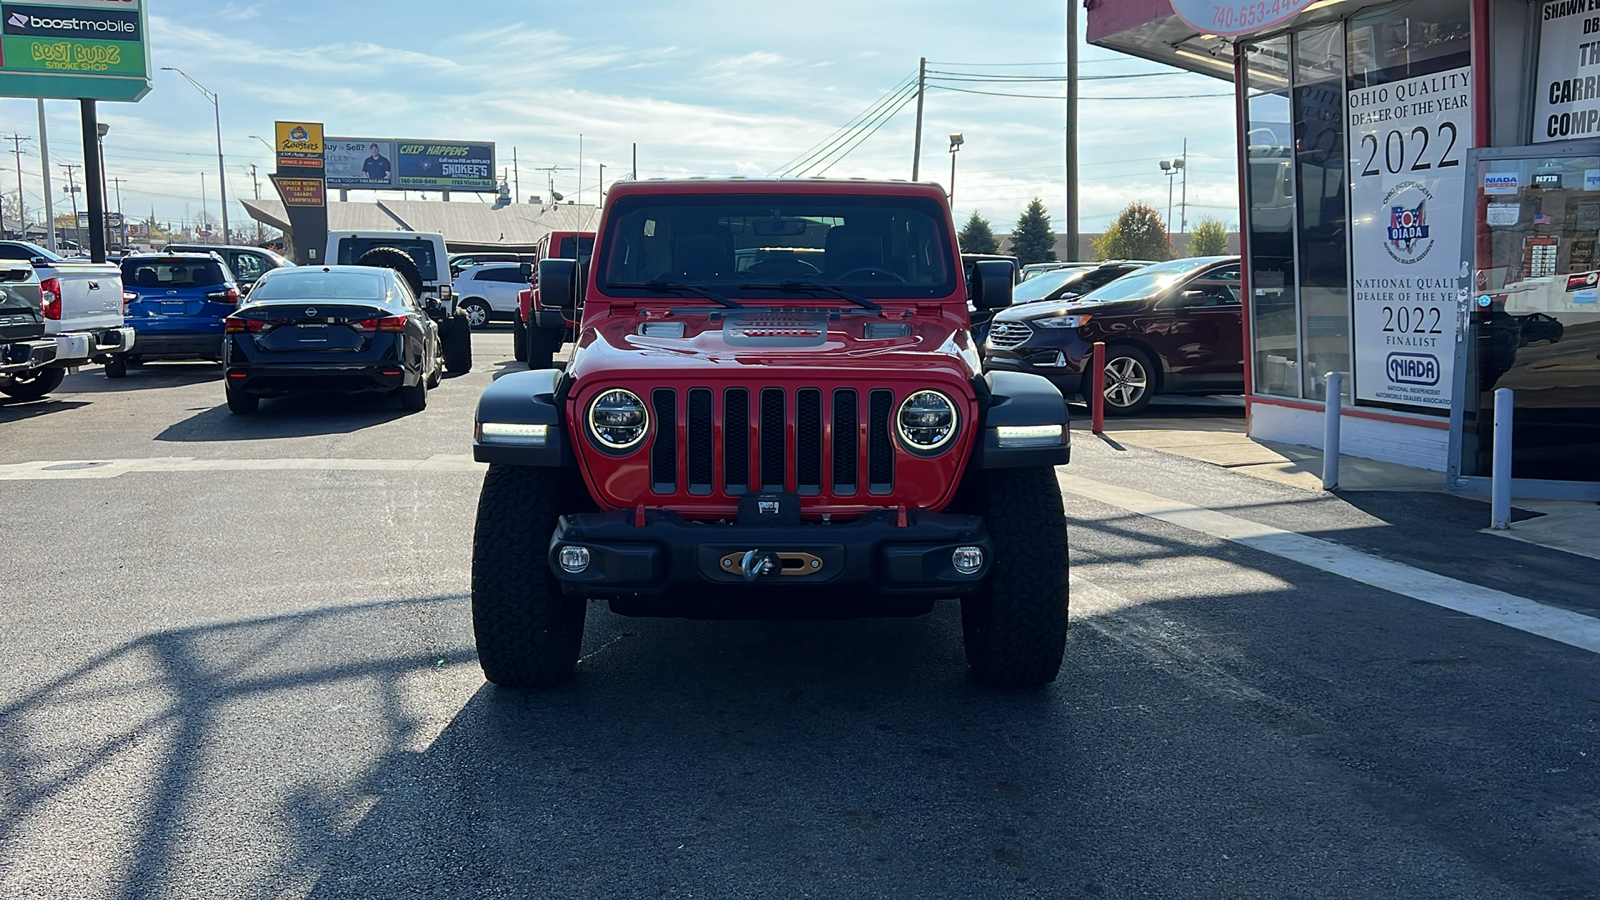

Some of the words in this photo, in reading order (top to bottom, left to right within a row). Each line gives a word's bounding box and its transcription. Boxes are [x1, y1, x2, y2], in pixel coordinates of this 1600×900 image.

[1544, 0, 1586, 20] SHAWN
[46, 61, 79, 71] SMOKE
[81, 63, 108, 71] SHOP
[1350, 88, 1388, 108] OHIO
[1396, 71, 1470, 102] QUALITY
[1352, 108, 1392, 126] DEALER
[1394, 105, 1409, 119] OF
[1411, 100, 1434, 116] THE
[1437, 94, 1469, 112] YEAR
[282, 139, 319, 151] Roosters
[346, 143, 365, 151] Sell?
[400, 145, 425, 155] CHIP
[426, 145, 470, 157] HAPPENS
[1361, 121, 1459, 177] 2022
[1392, 227, 1422, 239] OIADA
[1355, 278, 1412, 289] NATIONAL
[1357, 292, 1394, 301] DEALER
[1398, 292, 1411, 301] OF
[1416, 293, 1435, 301] THE
[1382, 306, 1442, 334] 2022
[1386, 336, 1437, 347] FINALIST
[1390, 359, 1435, 379] NIADA
